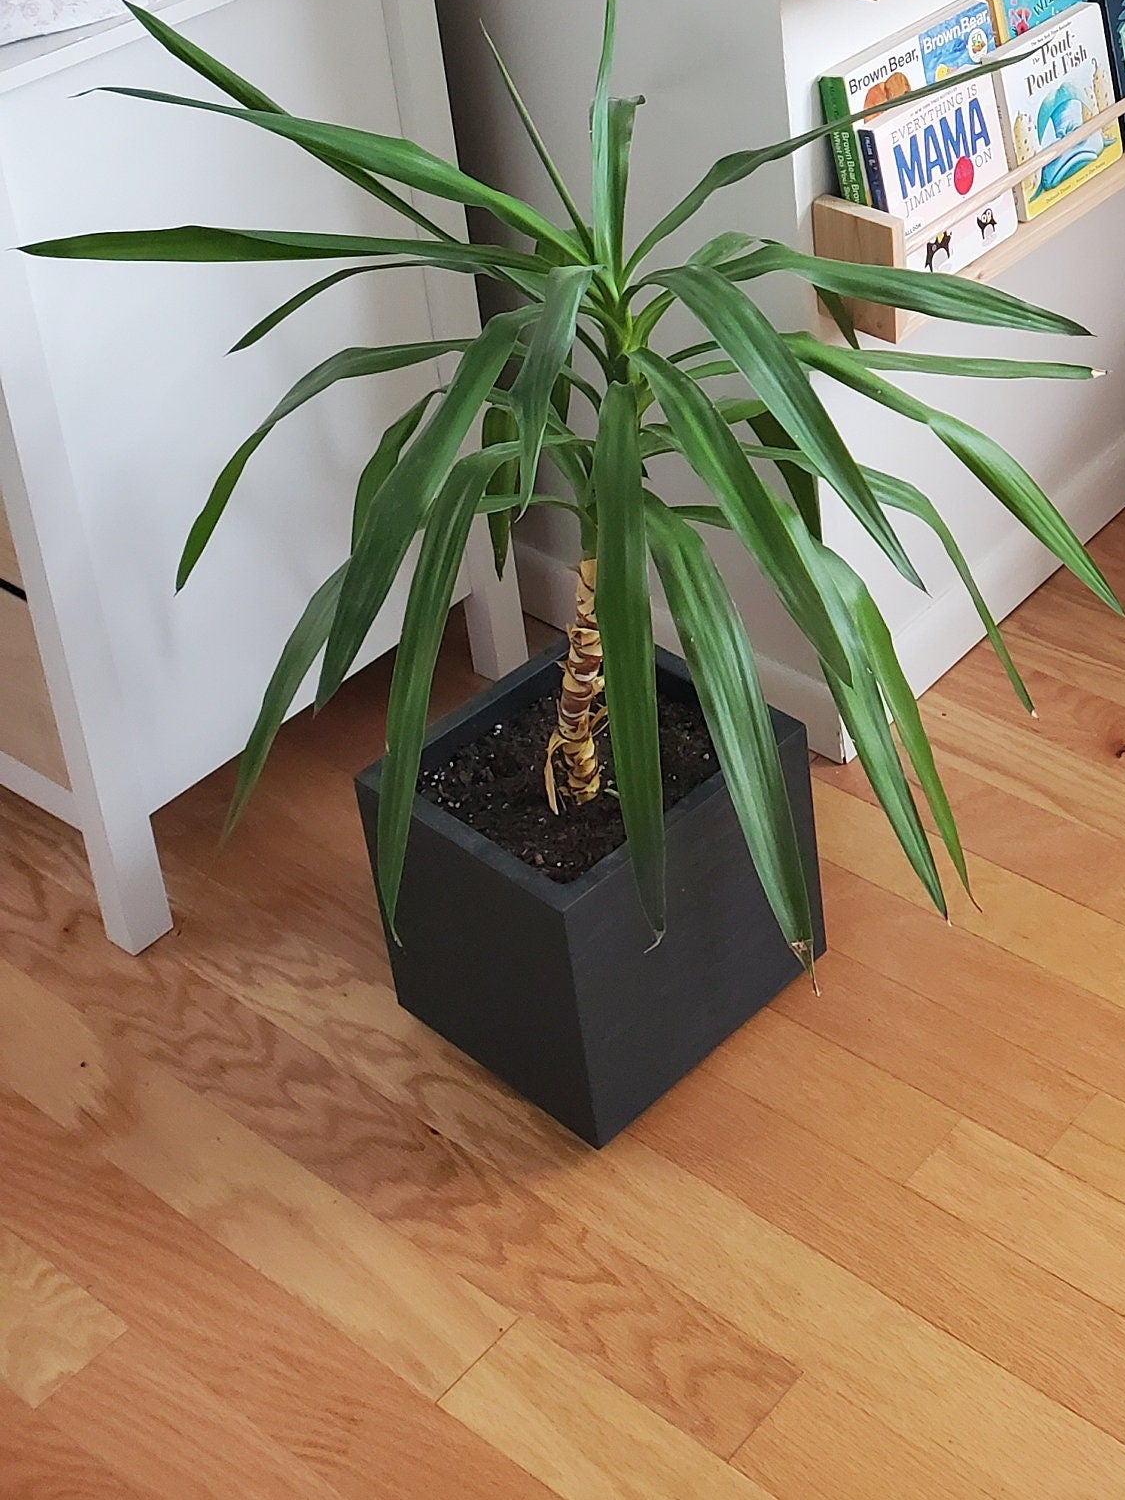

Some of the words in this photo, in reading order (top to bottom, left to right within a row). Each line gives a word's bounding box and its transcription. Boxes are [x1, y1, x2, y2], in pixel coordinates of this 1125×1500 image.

[849, 65, 888, 95] Brown
[888, 48, 919, 73] Bear,
[923, 26, 962, 54] Brown
[960, 9, 990, 33] Bear,
[1025, 61, 1058, 96] Pout
[1061, 44, 1088, 75] Fish
[1041, 30, 1075, 65] Pout-
[891, 92, 963, 145] EVERYTHING
[967, 84, 978, 99] IS
[833, 131, 843, 154] What
[837, 155, 845, 168] Do
[841, 131, 853, 160] Brown
[847, 161, 857, 183] Bear,
[893, 97, 991, 200] MAMA
[840, 169, 849, 186] You
[904, 178, 943, 218] JIMMY
